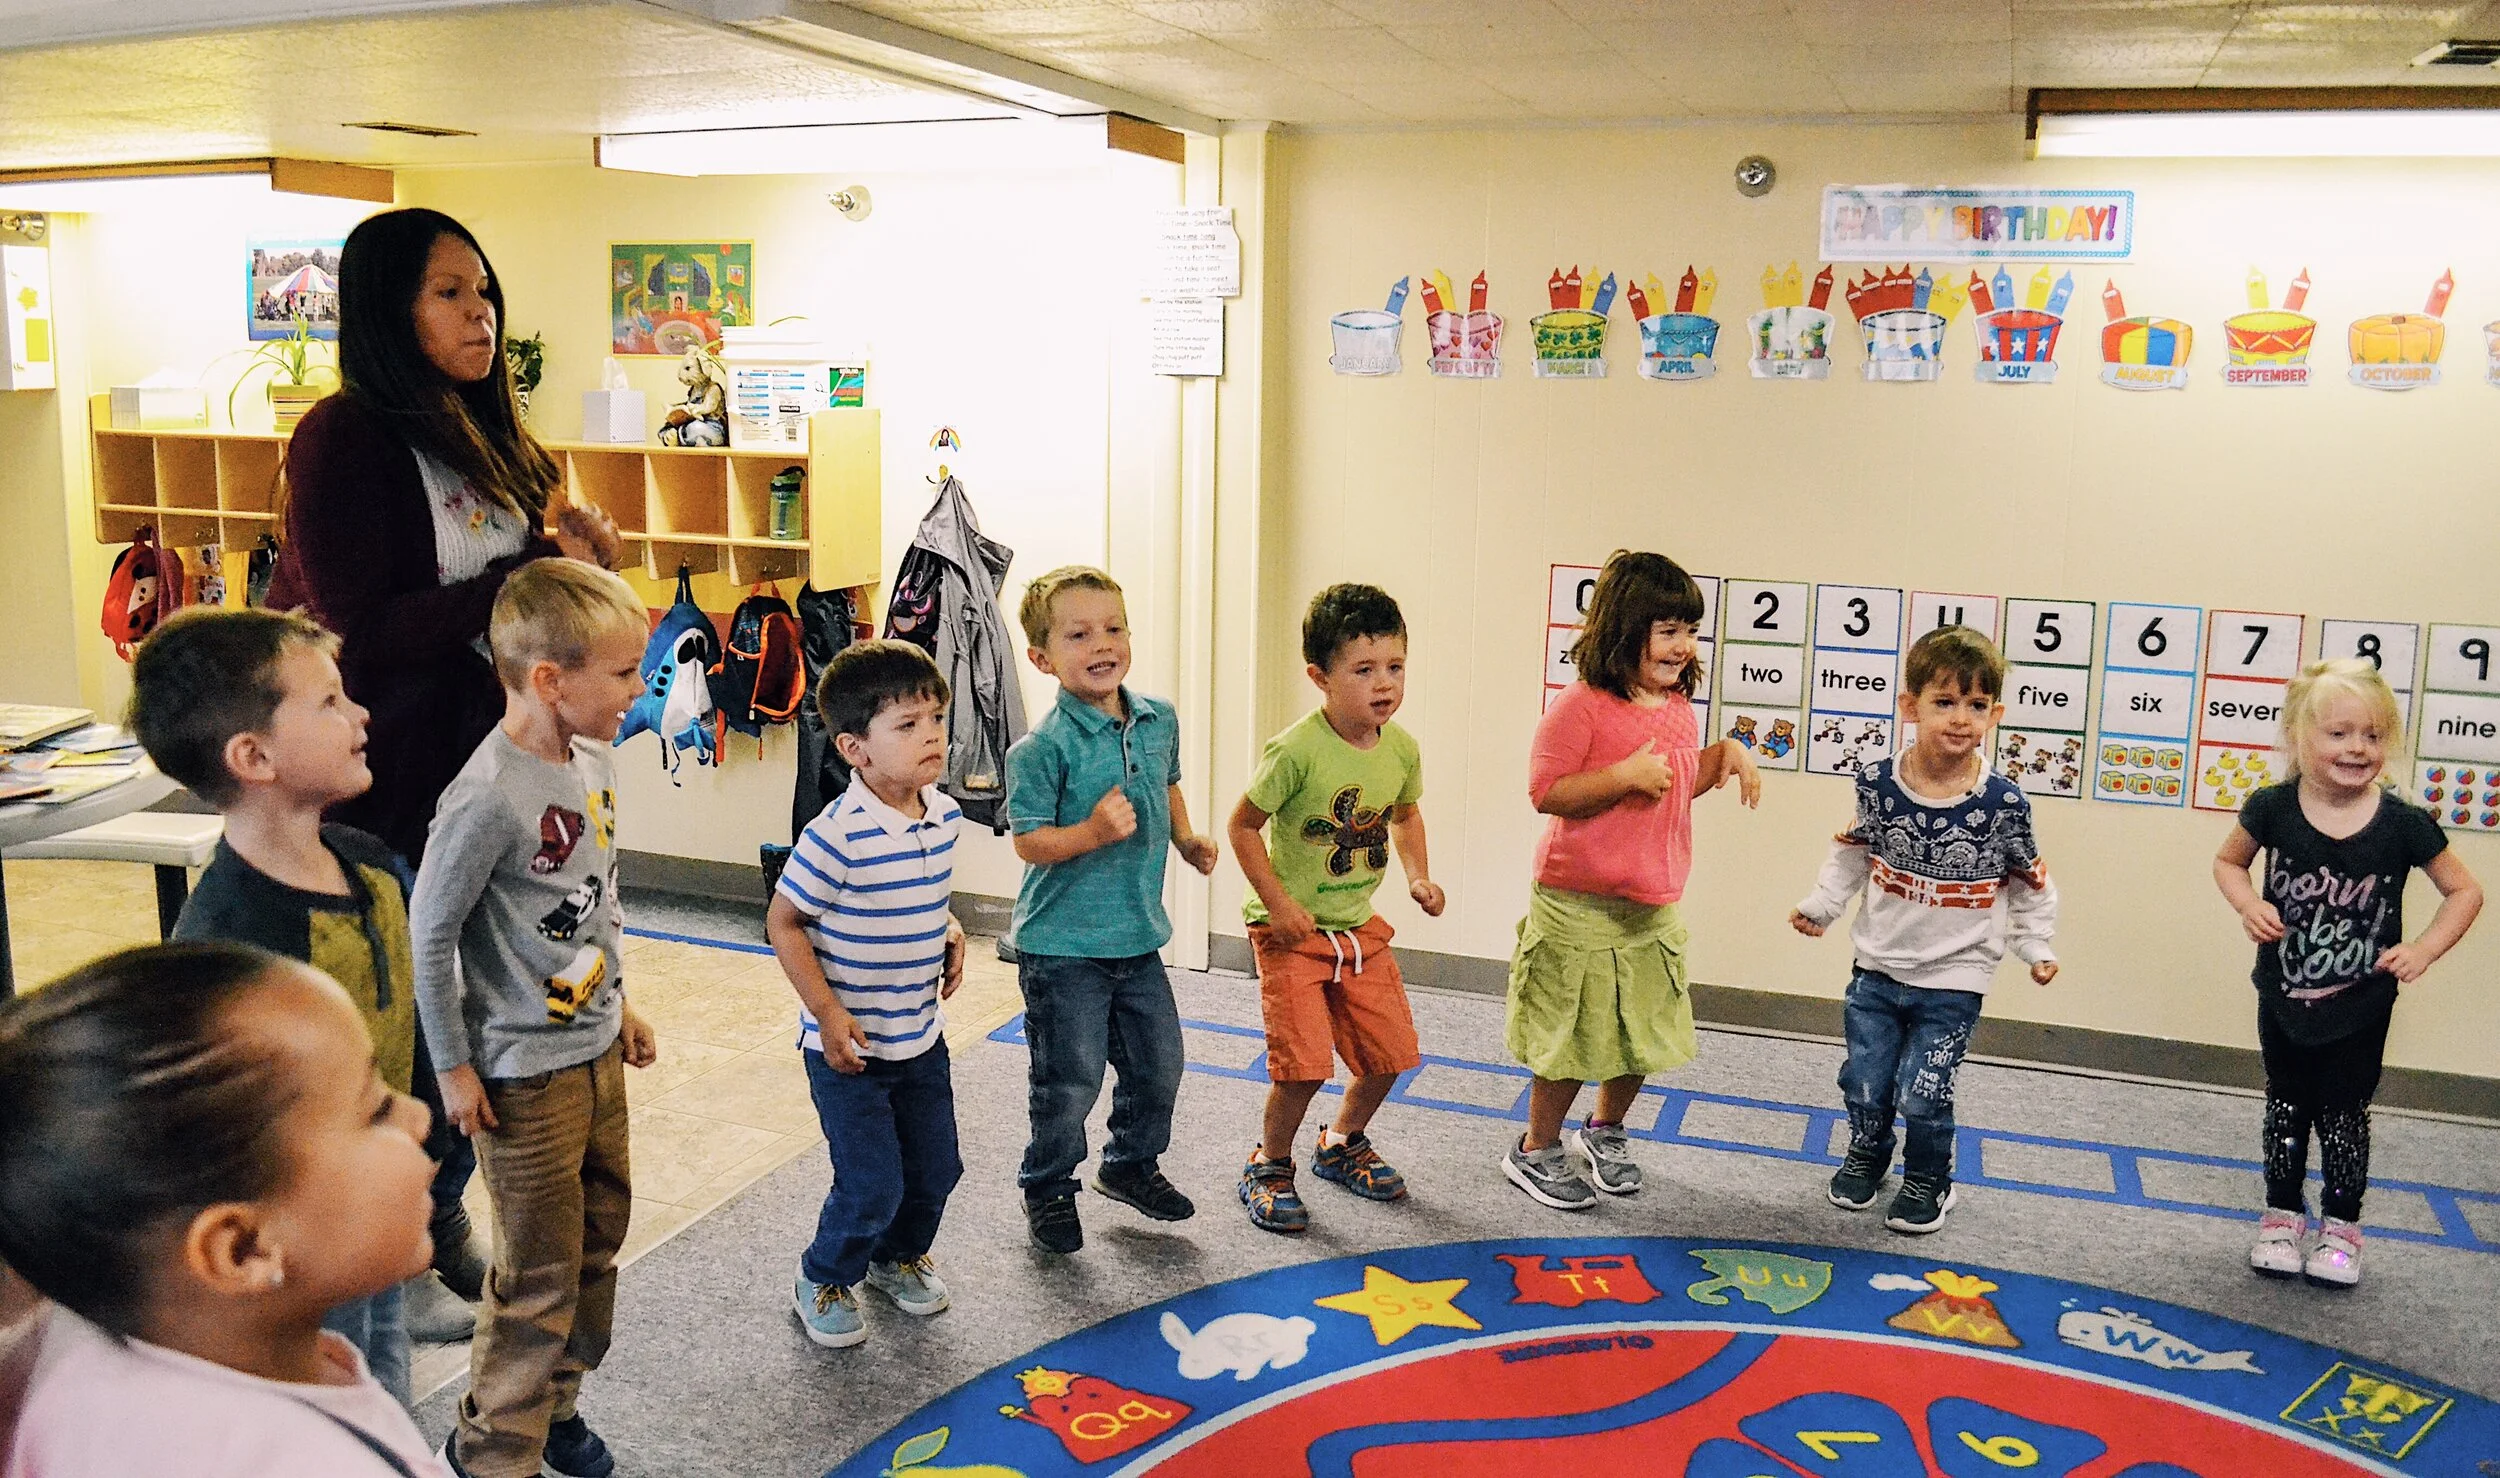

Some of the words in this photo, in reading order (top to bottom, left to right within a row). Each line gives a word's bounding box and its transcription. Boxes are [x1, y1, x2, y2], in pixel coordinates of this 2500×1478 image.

[1834, 205, 1945, 241] HAPPY
[1952, 205, 2118, 242] BIRTHDAY!
[1339, 358, 1392, 370] JANUARY
[1658, 361, 1695, 374] APRIL
[1998, 365, 2031, 379] JULY
[2115, 366, 2176, 383] AUGUST
[2227, 369, 2307, 383] SEPTEMBER
[2360, 367, 2432, 381] OCTOBER
[1753, 591, 1779, 630] 2
[1843, 598, 1870, 637] 3
[2033, 612, 2062, 652] 5
[2137, 617, 2167, 657] 6
[2241, 626, 2269, 665] 7
[2355, 633, 2382, 671] 8
[2459, 638, 2490, 680] 9
[1741, 663, 1783, 684] two
[1821, 669, 1887, 691] three
[2018, 685, 2069, 707] five
[2130, 692, 2163, 713] six
[2437, 715, 2496, 738] nine
[2270, 847, 2377, 911] born
[2309, 903, 2353, 946] be
[1737, 1264, 1808, 1288] Uu
[1371, 1294, 1434, 1317] Ss
[1922, 1308, 1993, 1341] Vv
[2104, 1325, 2204, 1365] Ww
[1070, 1400, 1172, 1440] Qq
